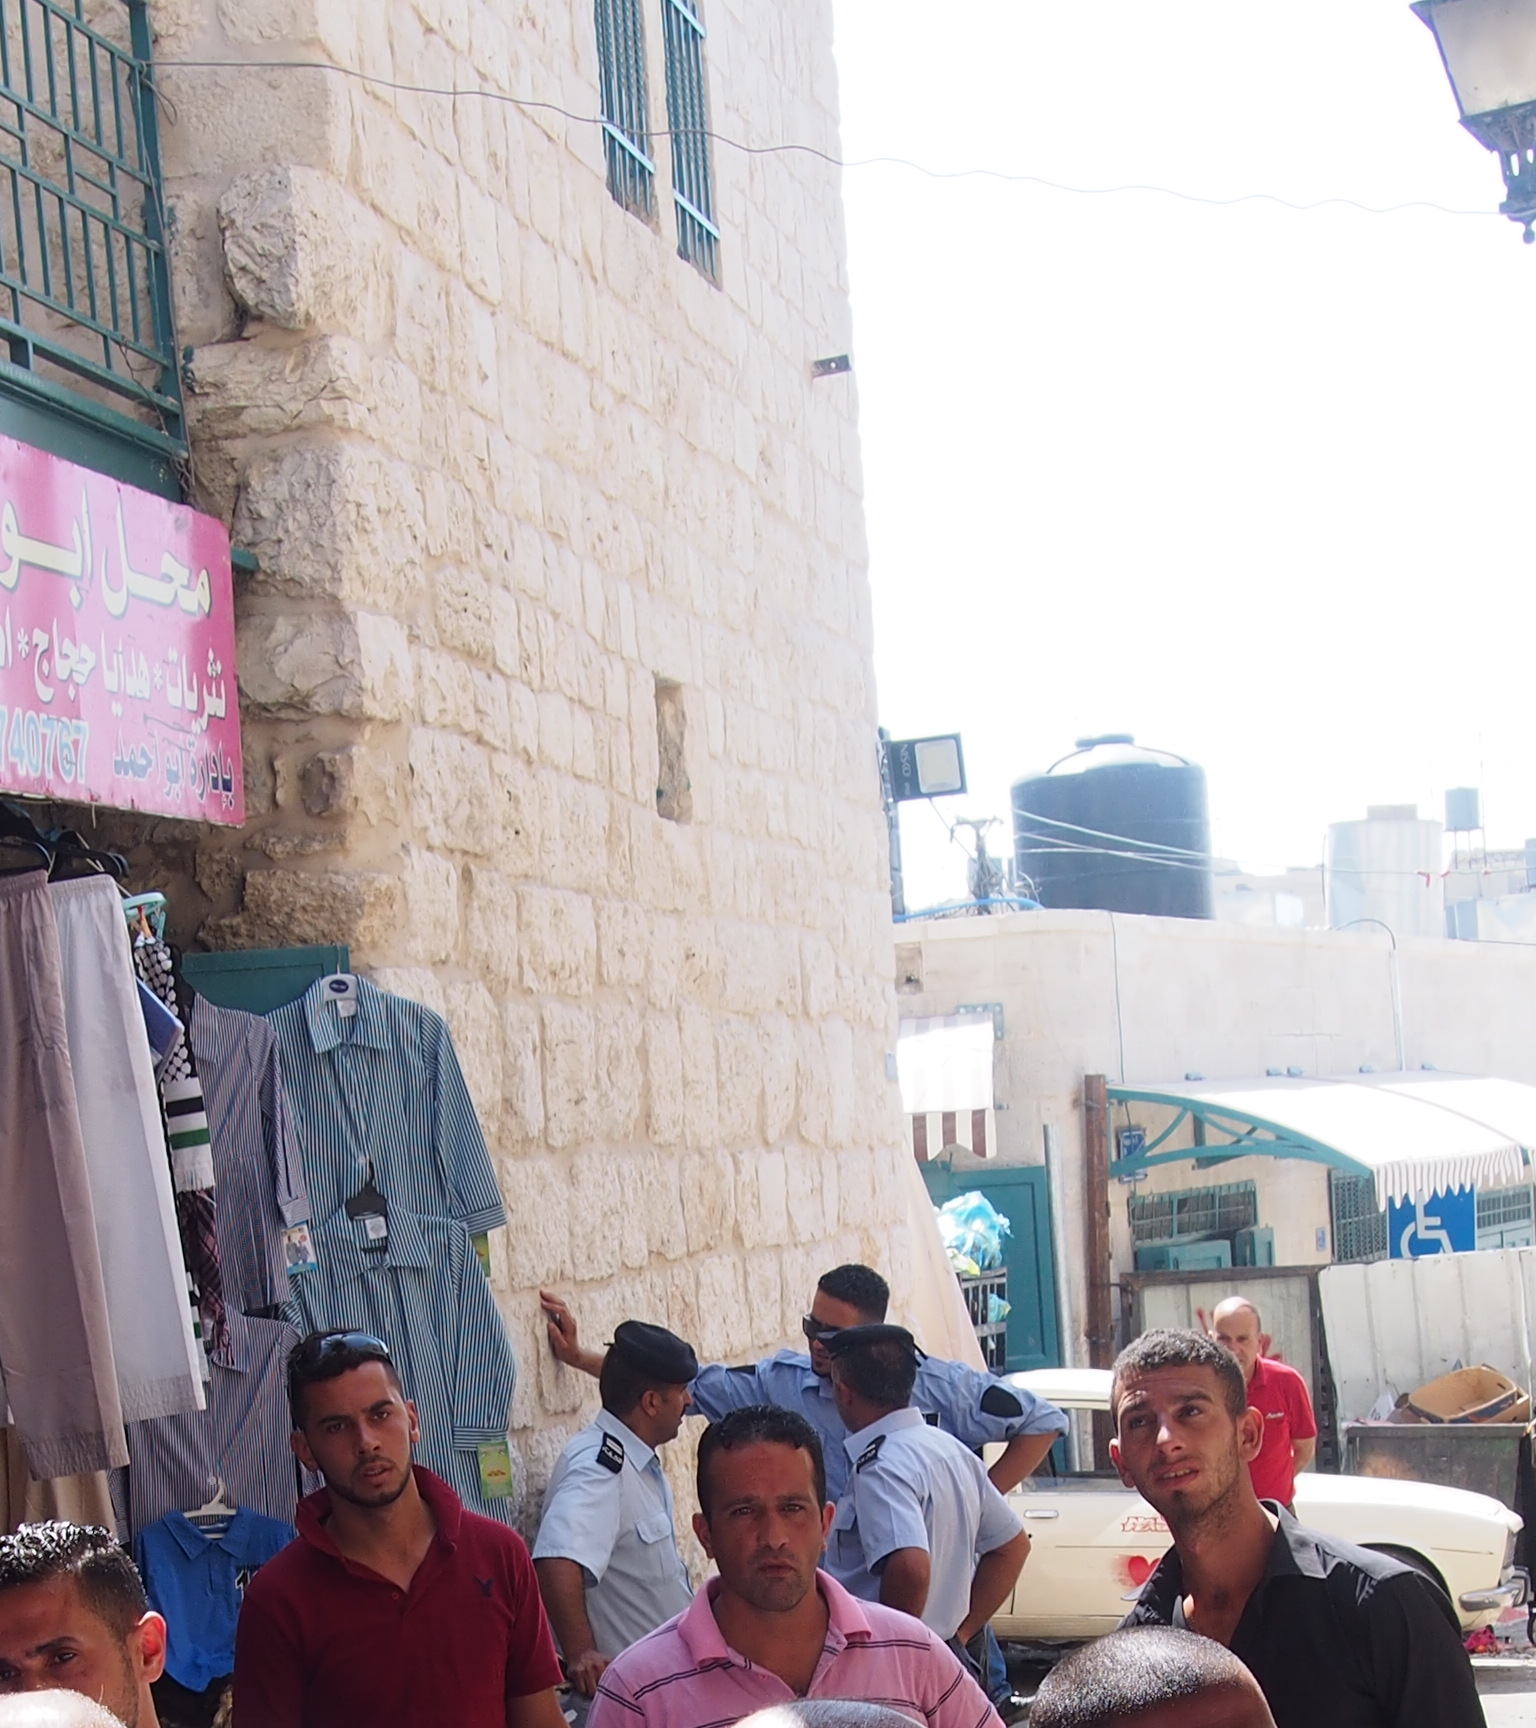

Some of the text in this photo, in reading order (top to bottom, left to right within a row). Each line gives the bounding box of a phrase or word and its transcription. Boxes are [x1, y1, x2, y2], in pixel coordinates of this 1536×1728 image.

[101, 499, 211, 620] محل
[32, 617, 96, 703] حجاج
[100, 630, 151, 718] هدايا
